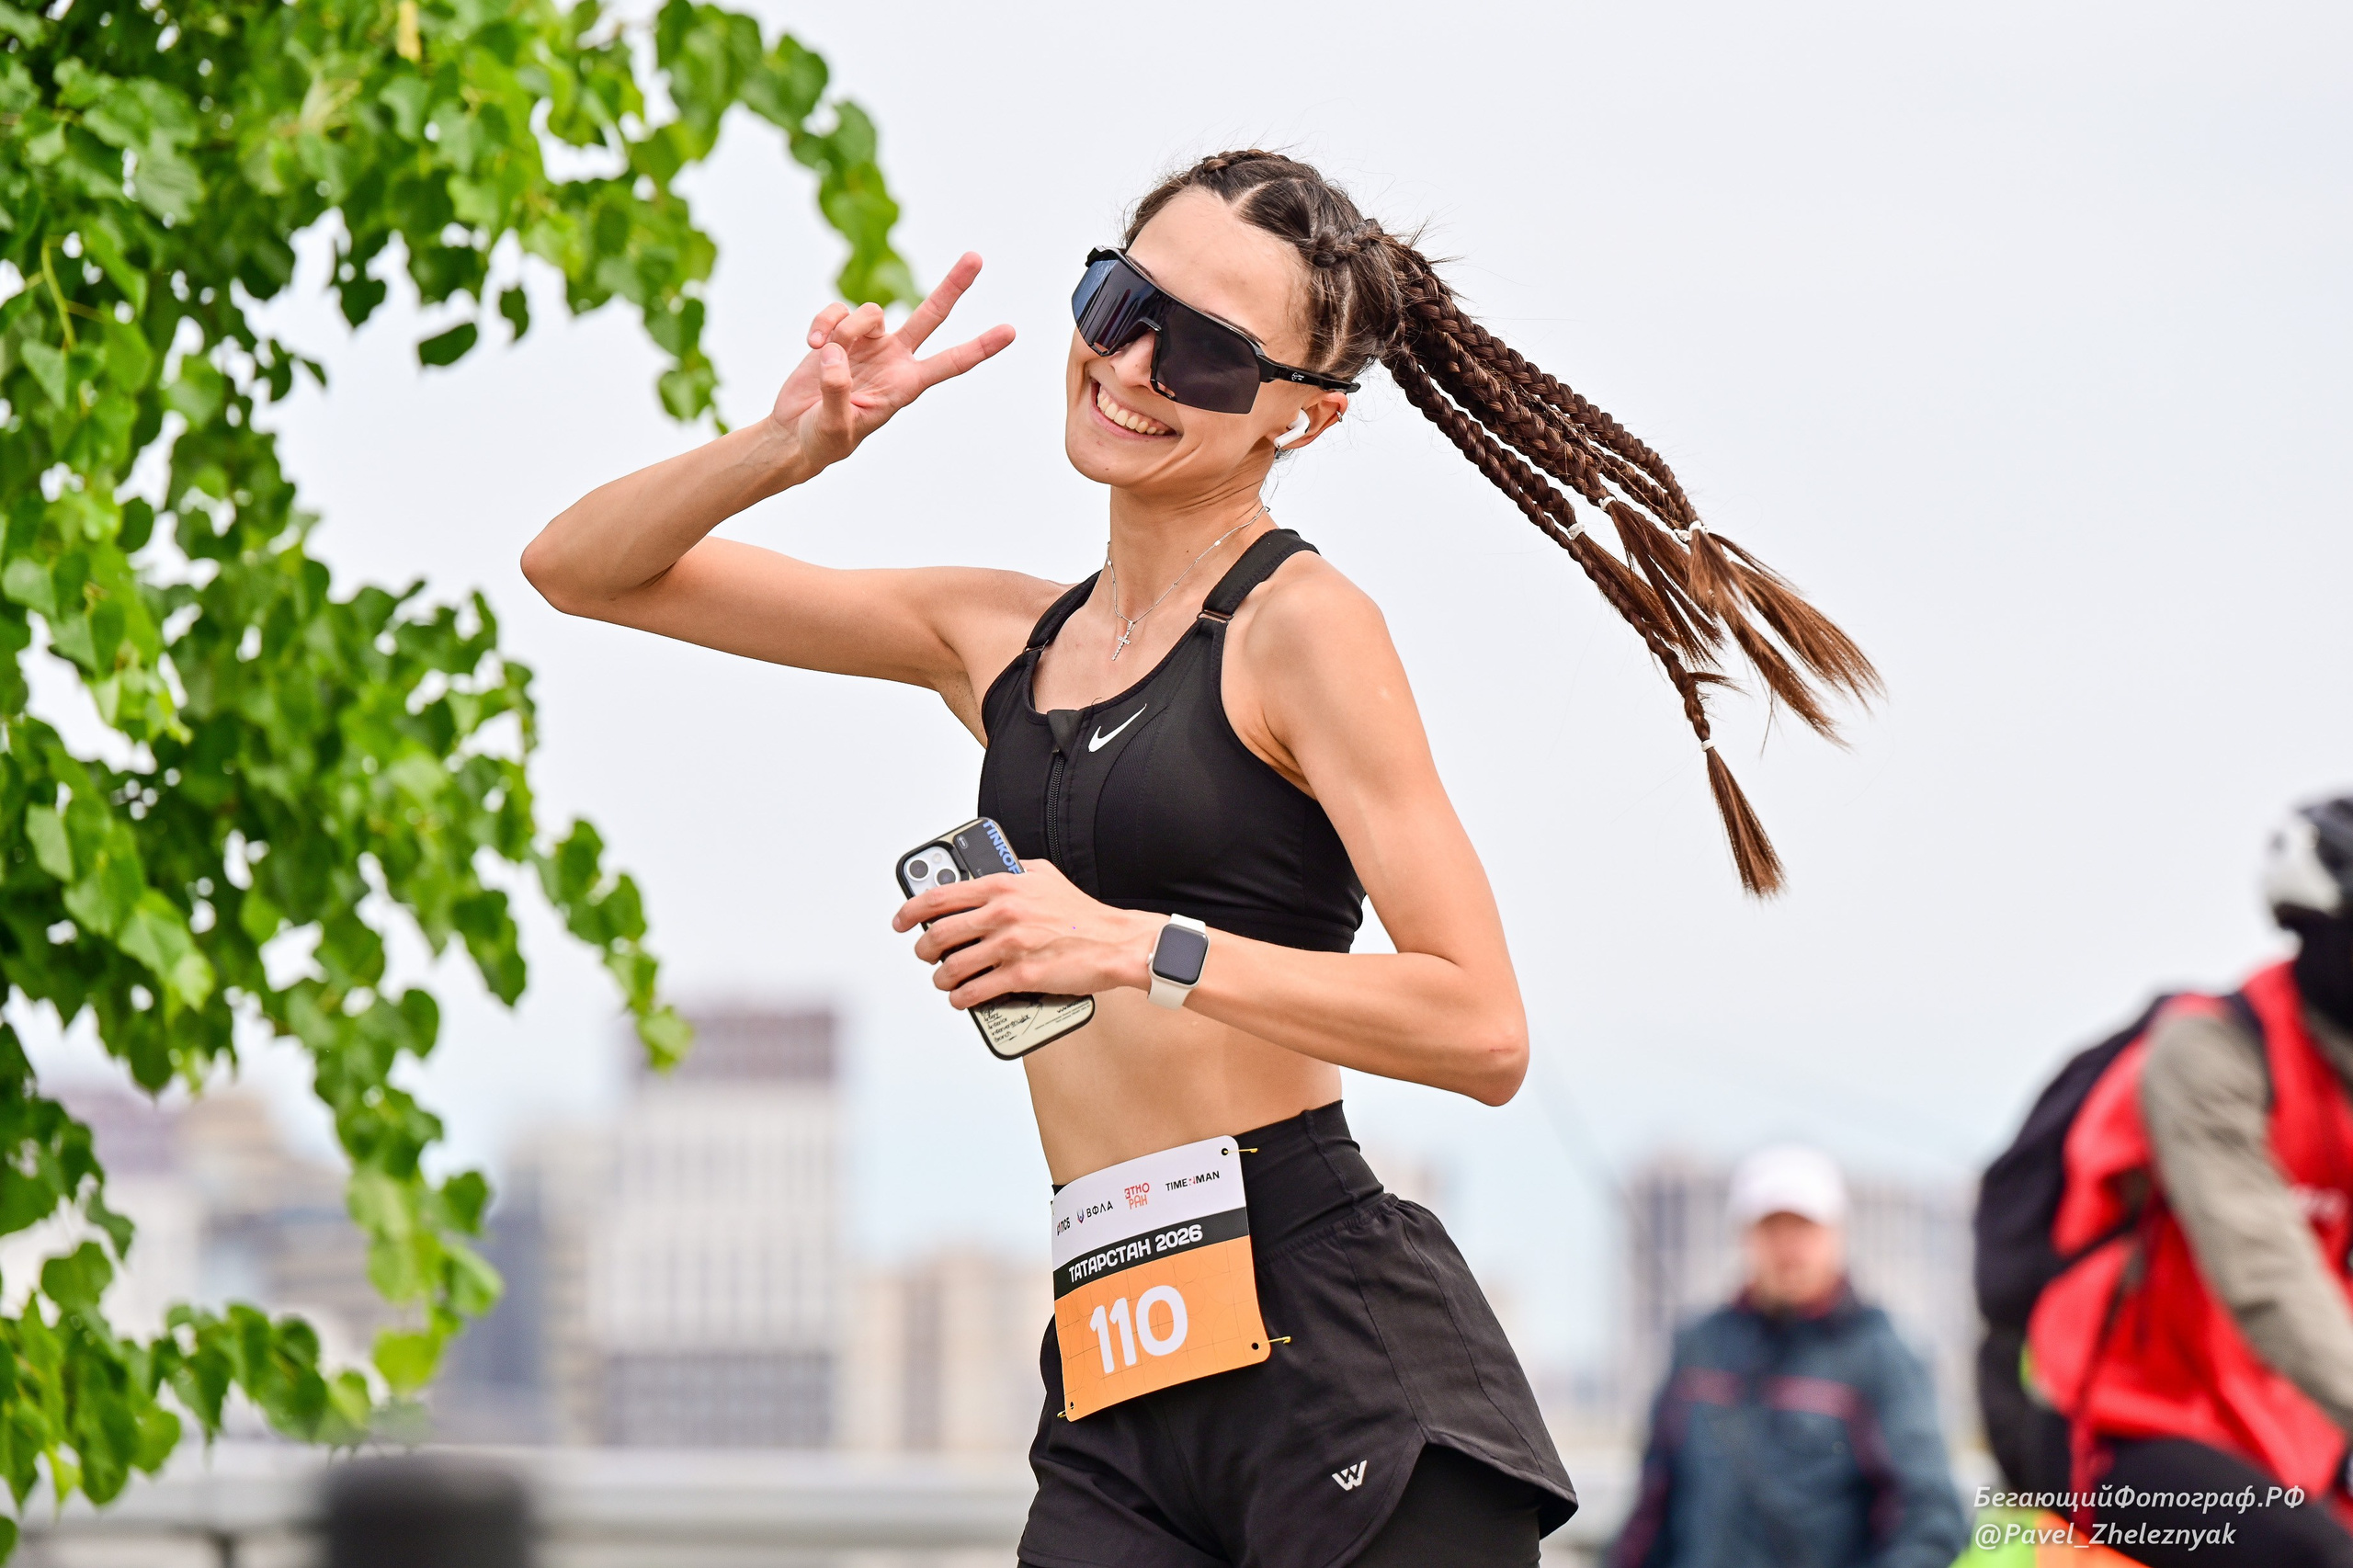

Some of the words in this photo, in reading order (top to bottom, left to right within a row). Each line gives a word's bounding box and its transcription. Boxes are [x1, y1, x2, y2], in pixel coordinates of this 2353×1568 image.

[1068, 1239, 1152, 1283] ТАТАРСТАН
[1155, 1224, 1203, 1252] 2026
[1089, 1285, 1188, 1374] 110
